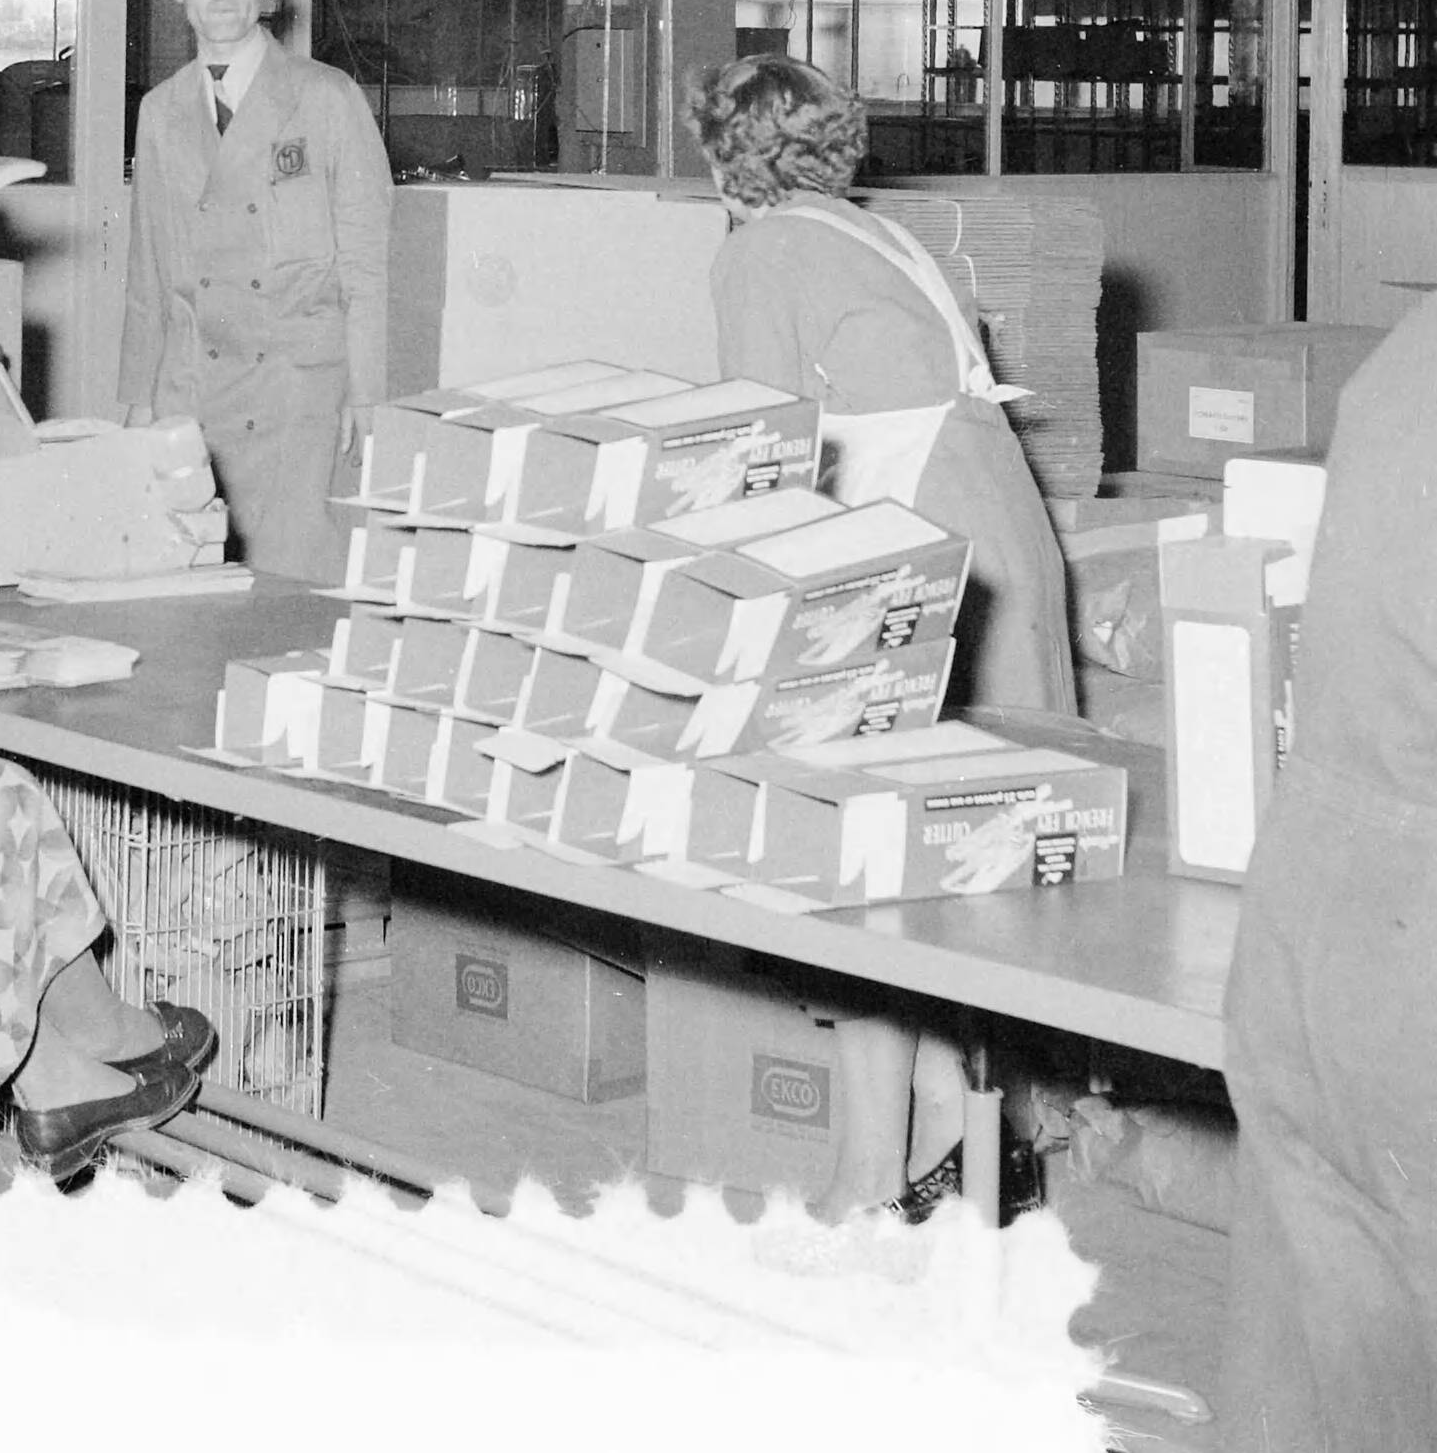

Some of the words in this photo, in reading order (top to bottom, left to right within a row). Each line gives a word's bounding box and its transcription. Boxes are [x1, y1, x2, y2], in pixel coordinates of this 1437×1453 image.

[923, 821, 971, 844] CUTTER
[1036, 812, 1060, 834] FRY
[1065, 809, 1114, 834] FRENCH
[771, 1078, 814, 1106] EKCO
